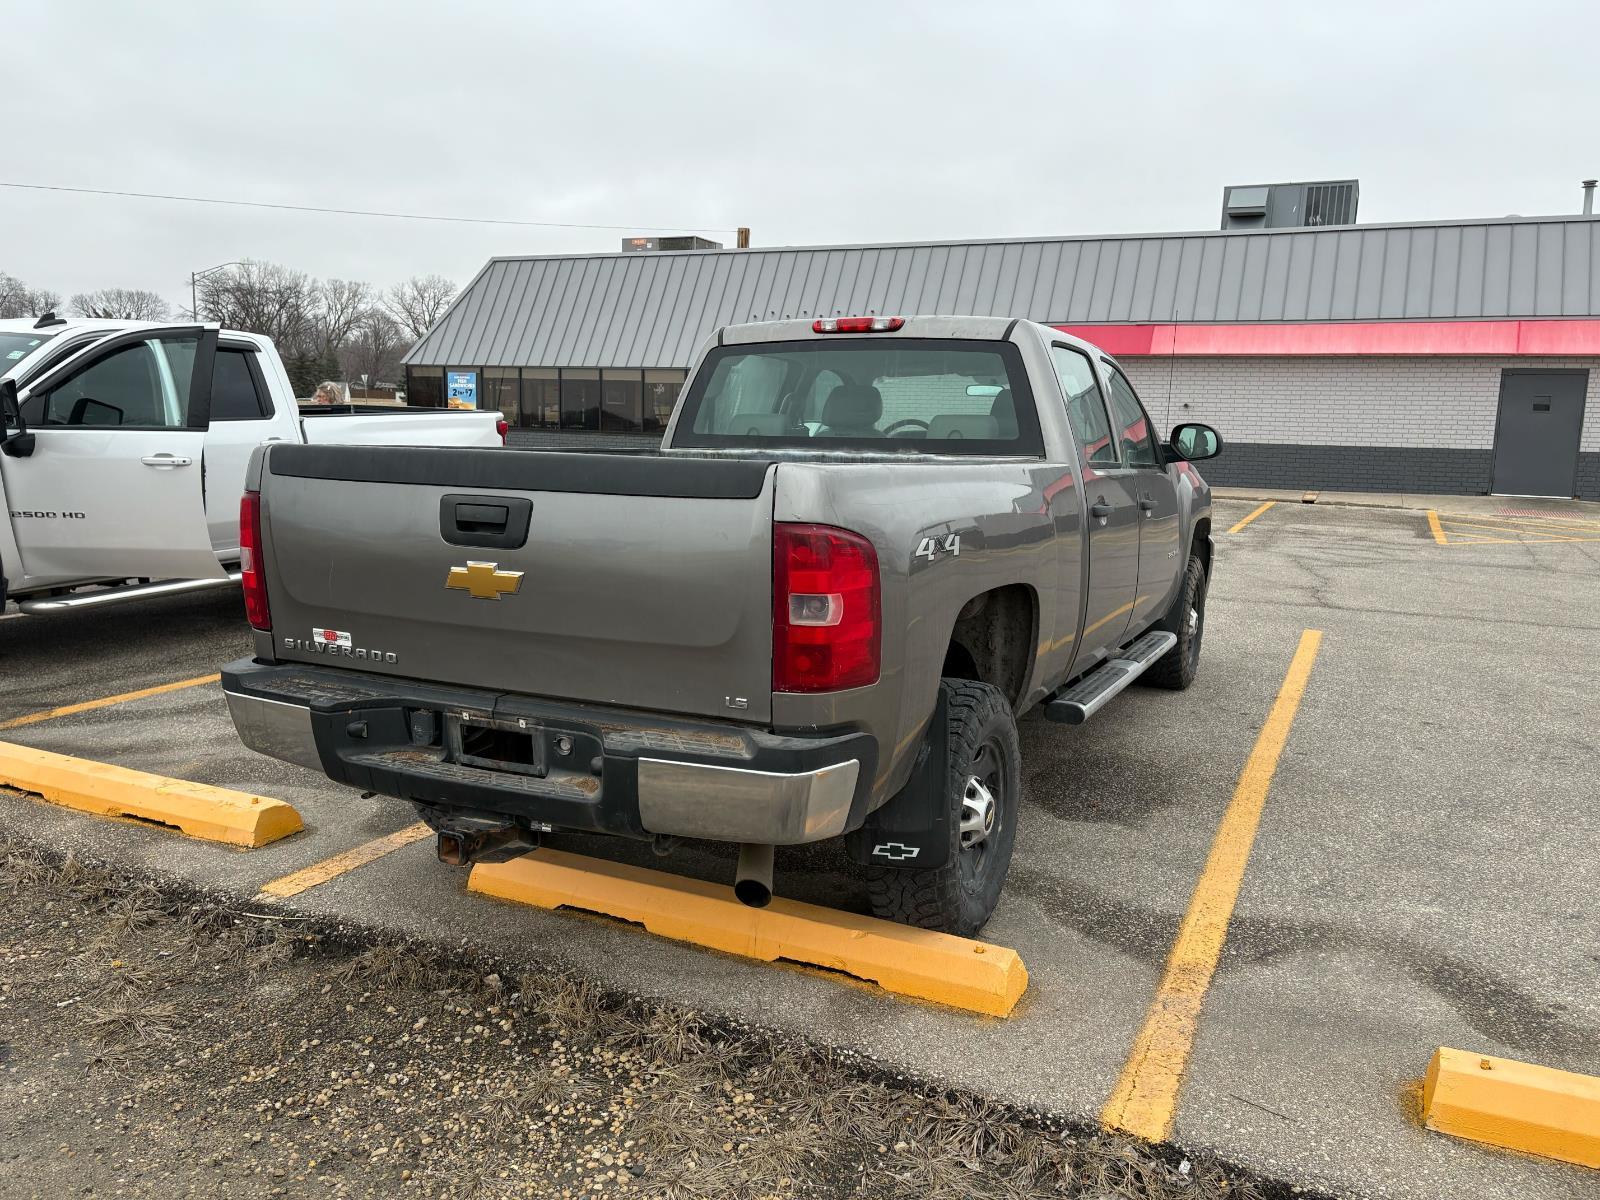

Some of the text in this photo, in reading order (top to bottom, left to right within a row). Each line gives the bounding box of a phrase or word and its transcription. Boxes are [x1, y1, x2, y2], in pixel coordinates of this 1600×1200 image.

[452, 389, 458, 397] 2
[9, 511, 57, 519] 2500
[284, 638, 399, 664] SILVERADO
